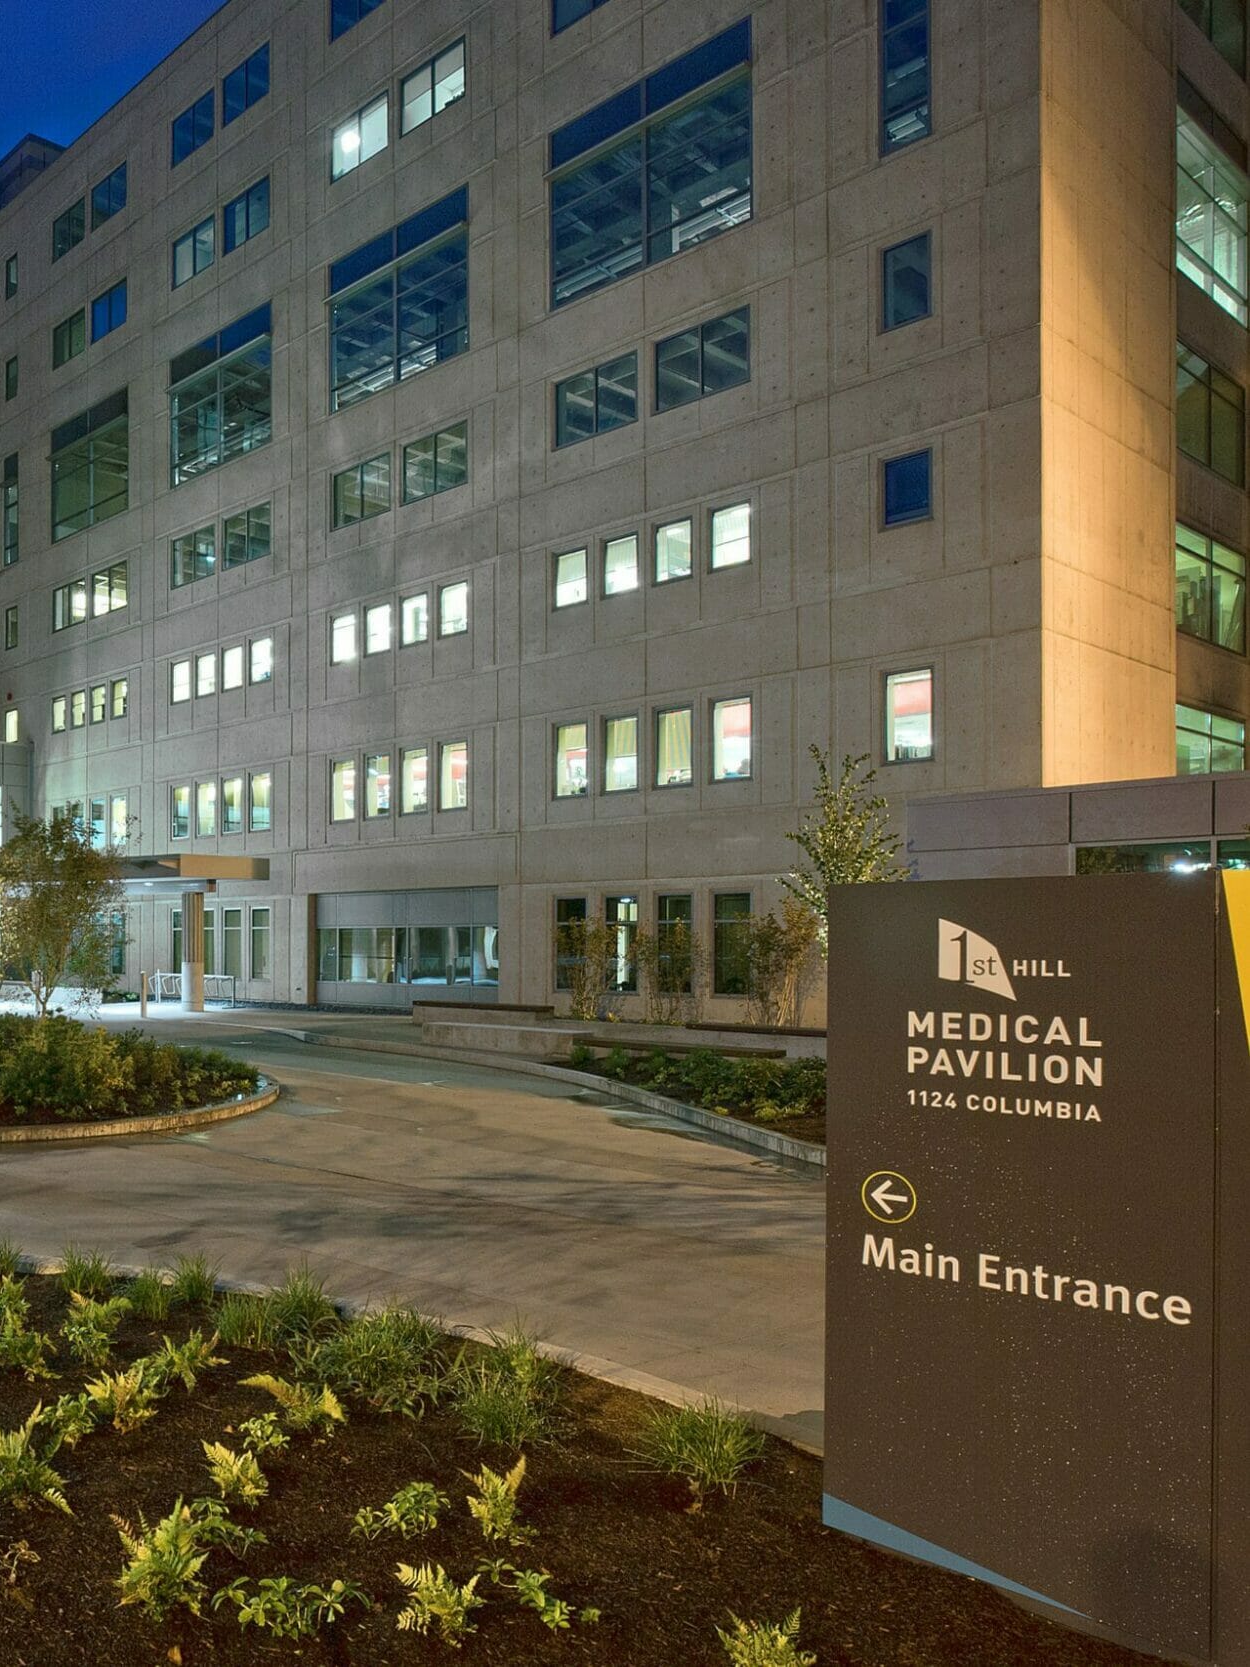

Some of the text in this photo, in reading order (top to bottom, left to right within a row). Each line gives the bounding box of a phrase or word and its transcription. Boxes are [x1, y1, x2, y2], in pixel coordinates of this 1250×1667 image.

[950, 930, 1072, 984] 1st HILL
[907, 1010, 1103, 1047] MEDICAL
[907, 1046, 1103, 1087] PAVILION
[907, 1089, 1102, 1122] 1124 COLUMBIA
[861, 1233, 1192, 1325] Main Entrance
